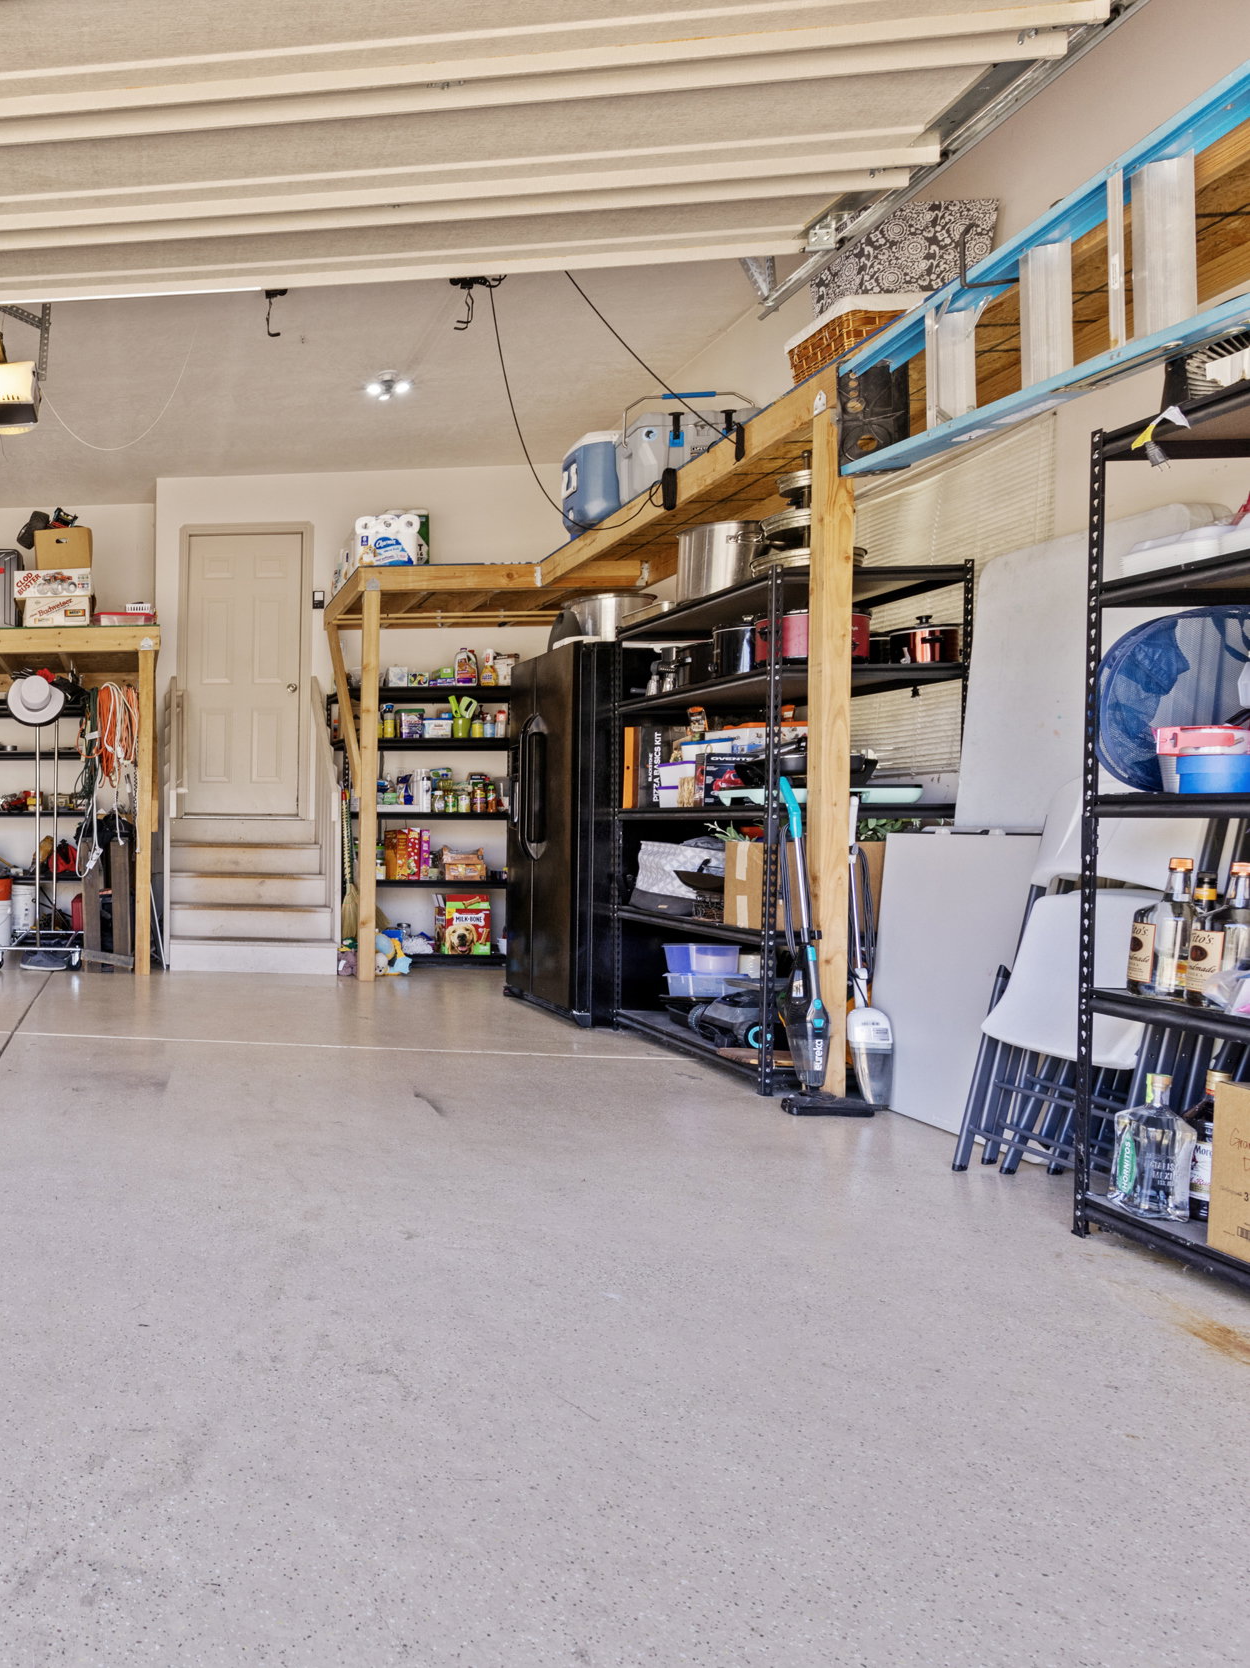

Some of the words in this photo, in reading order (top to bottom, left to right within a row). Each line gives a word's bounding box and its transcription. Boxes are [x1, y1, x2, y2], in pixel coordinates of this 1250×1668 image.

[15, 572, 33, 588] CLOD
[17, 573, 42, 596] BUSTER
[37, 598, 73, 617] Budweiser
[654, 732, 662, 746] KIT
[653, 745, 661, 776] BASICS
[652, 777, 660, 802] PIZZA
[813, 1039, 823, 1072] eureka
[1121, 1141, 1131, 1193] HORNITOS
